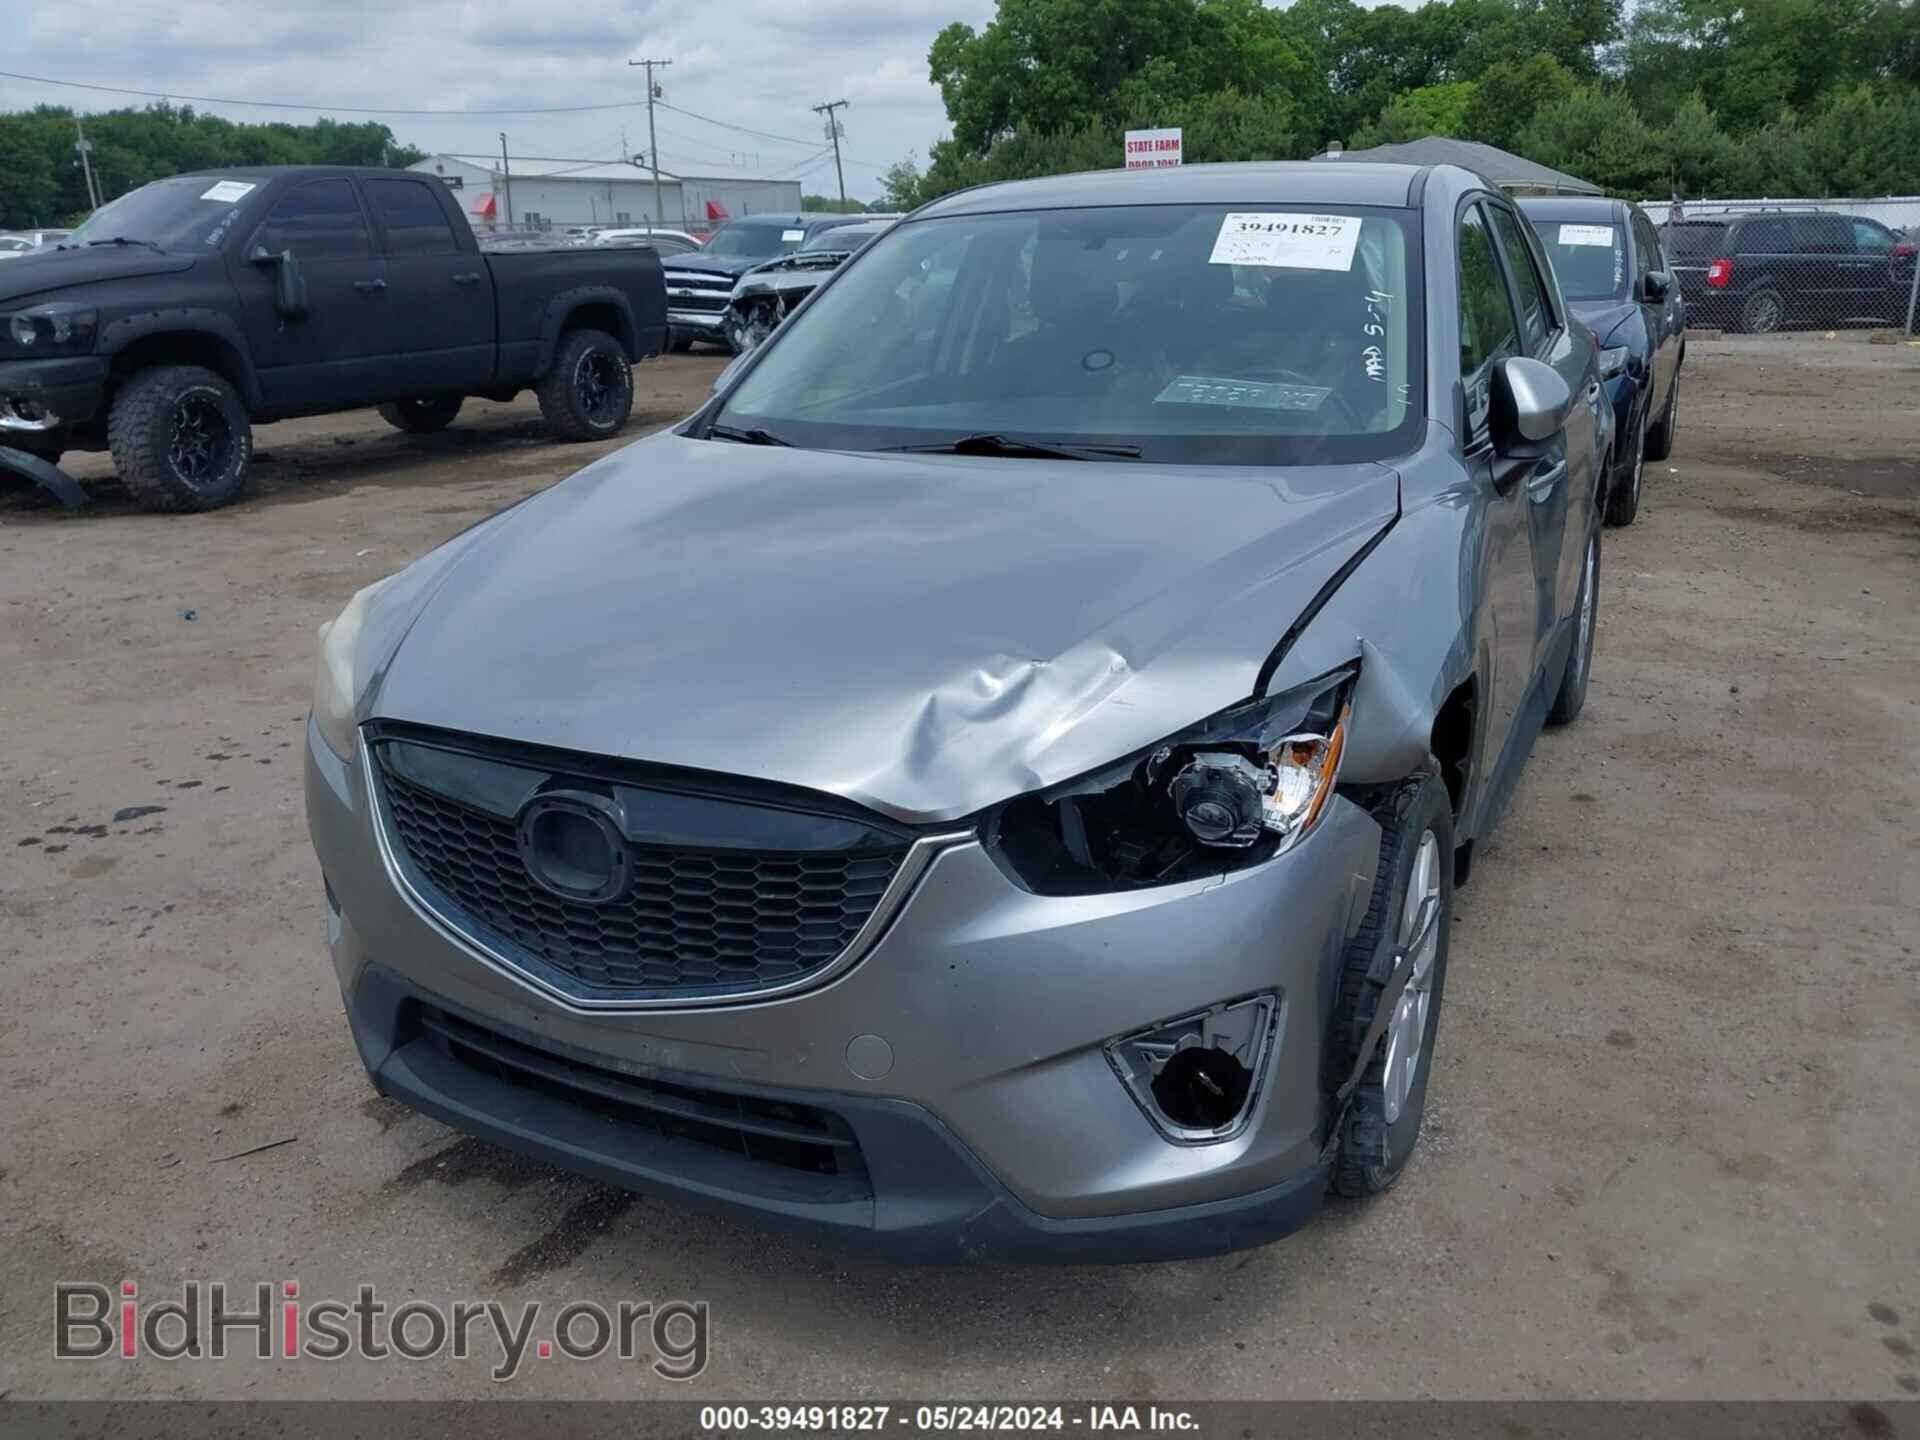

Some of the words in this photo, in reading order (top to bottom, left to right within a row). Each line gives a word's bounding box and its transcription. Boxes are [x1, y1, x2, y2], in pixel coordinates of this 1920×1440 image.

[1127, 141, 1152, 153] STATE
[1155, 139, 1179, 152] FARM
[1239, 222, 1343, 237] 39491827
